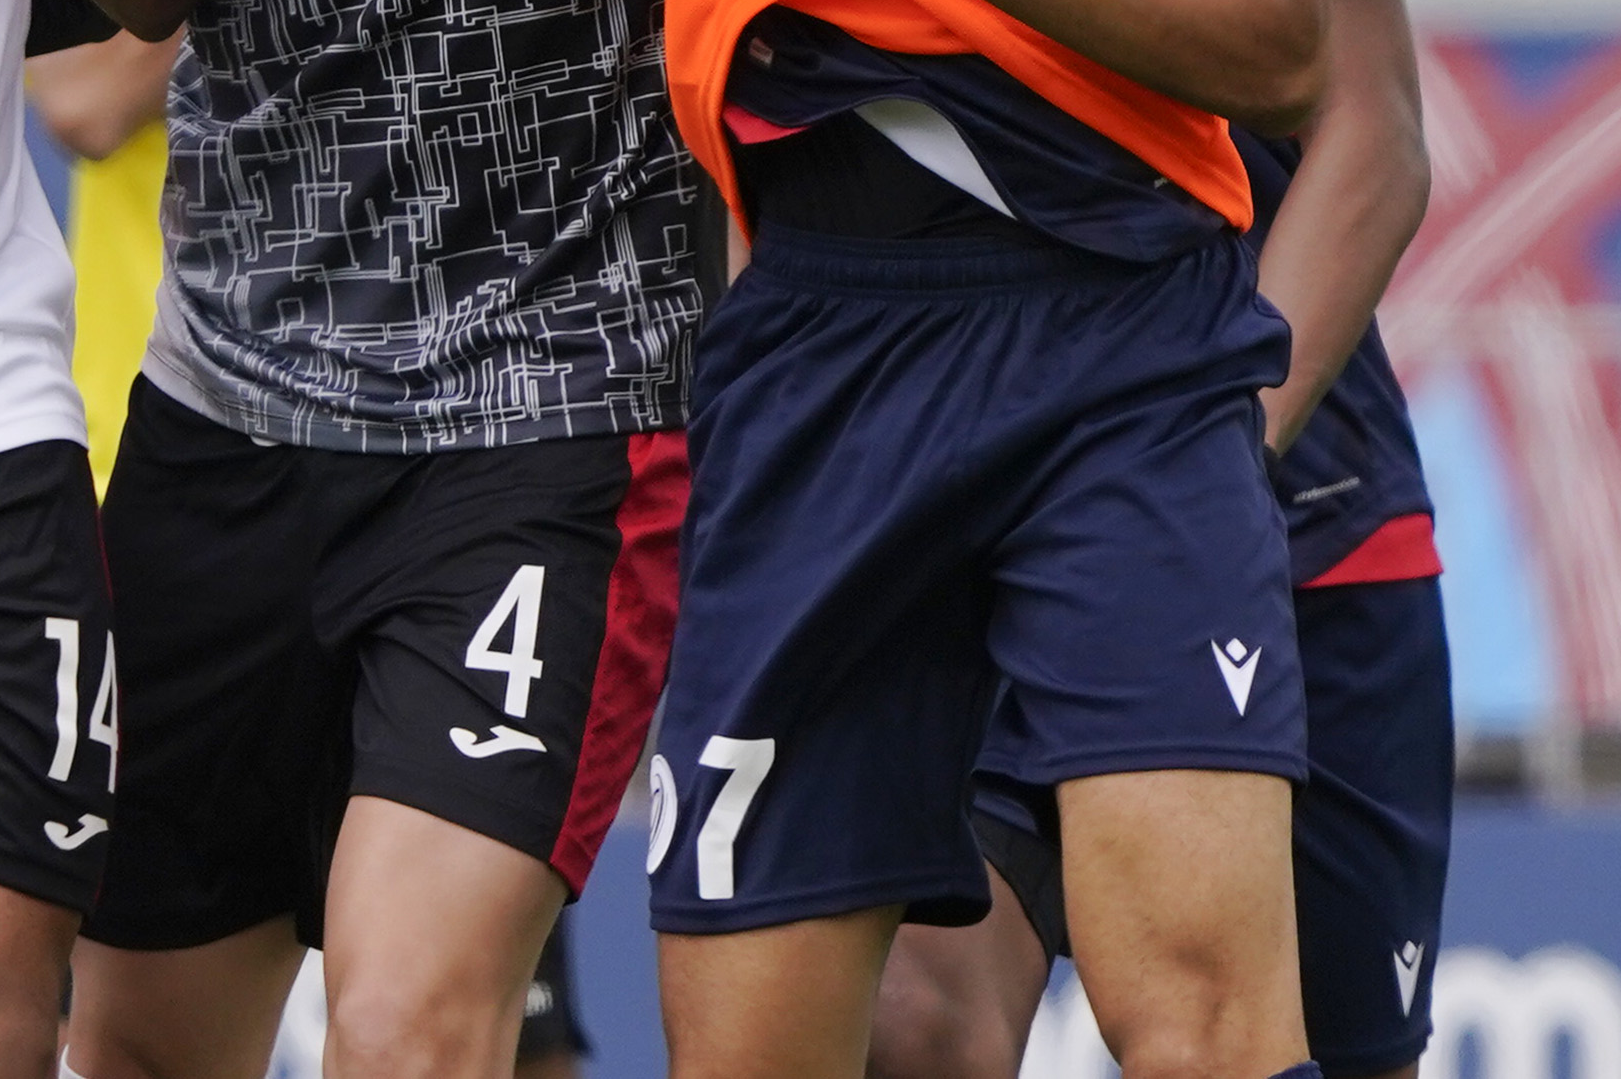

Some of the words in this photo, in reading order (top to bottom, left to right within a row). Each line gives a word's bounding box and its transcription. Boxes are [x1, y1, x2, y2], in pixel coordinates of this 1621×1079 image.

[45, 617, 119, 794] 14
[465, 564, 545, 718] 4
[697, 735, 776, 900] 7
